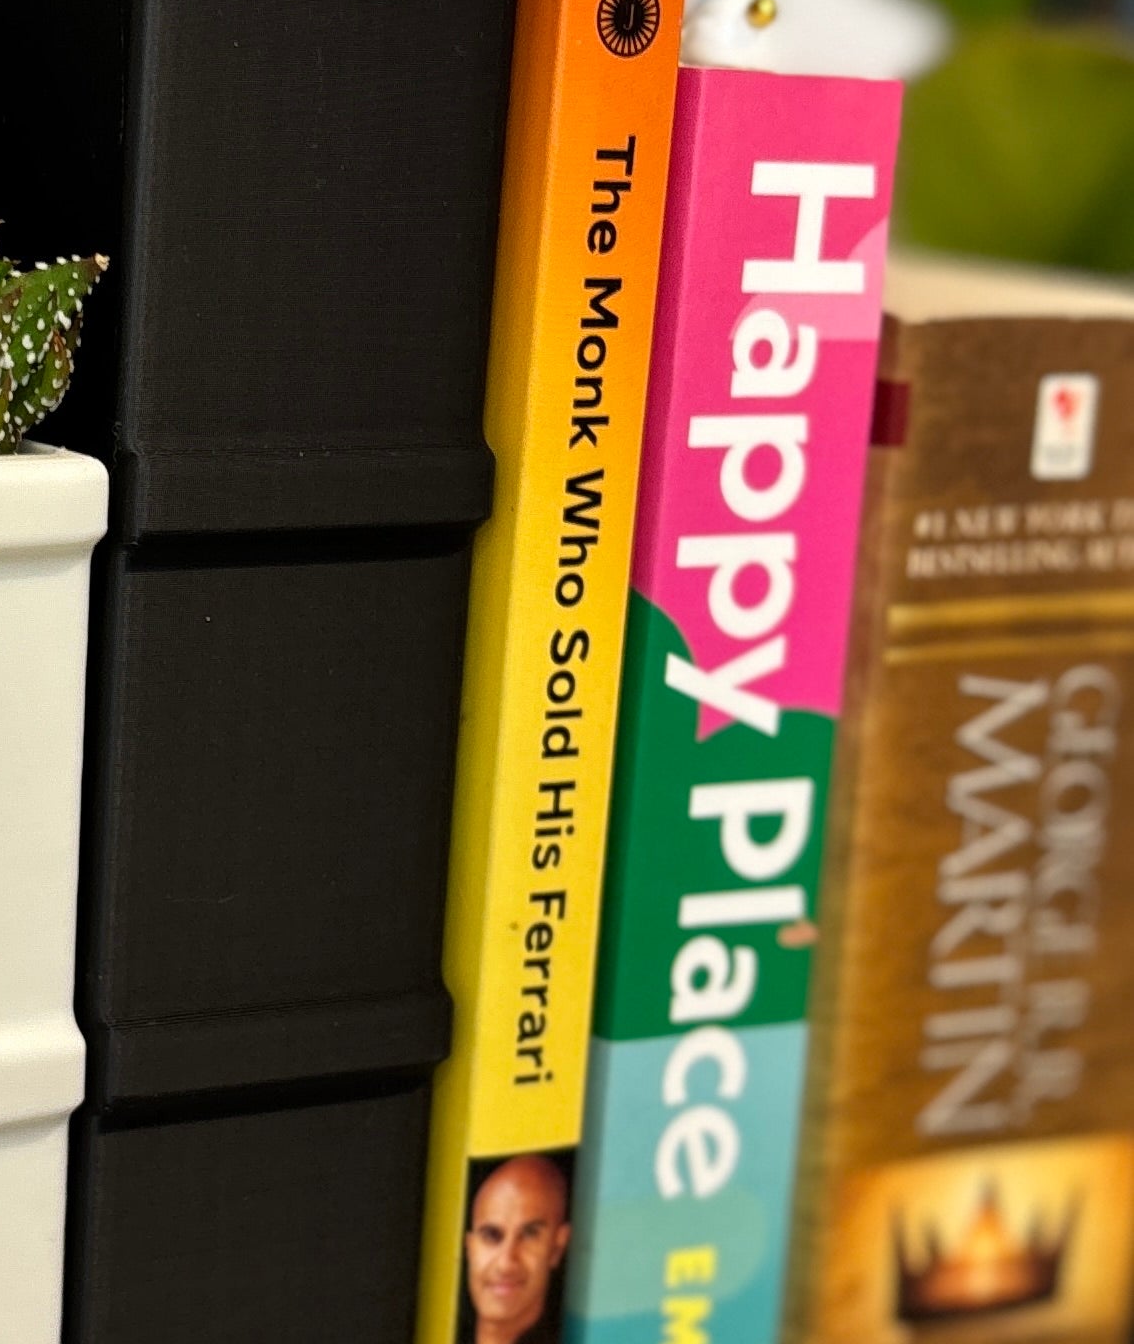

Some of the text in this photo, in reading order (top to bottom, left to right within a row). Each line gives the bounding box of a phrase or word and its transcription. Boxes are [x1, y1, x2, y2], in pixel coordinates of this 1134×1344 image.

[513, 135, 636, 1087] The Monk Who Sold His Ferrari
[656, 160, 876, 1199] Happy Place
[918, 673, 1049, 1137] MARTIN
